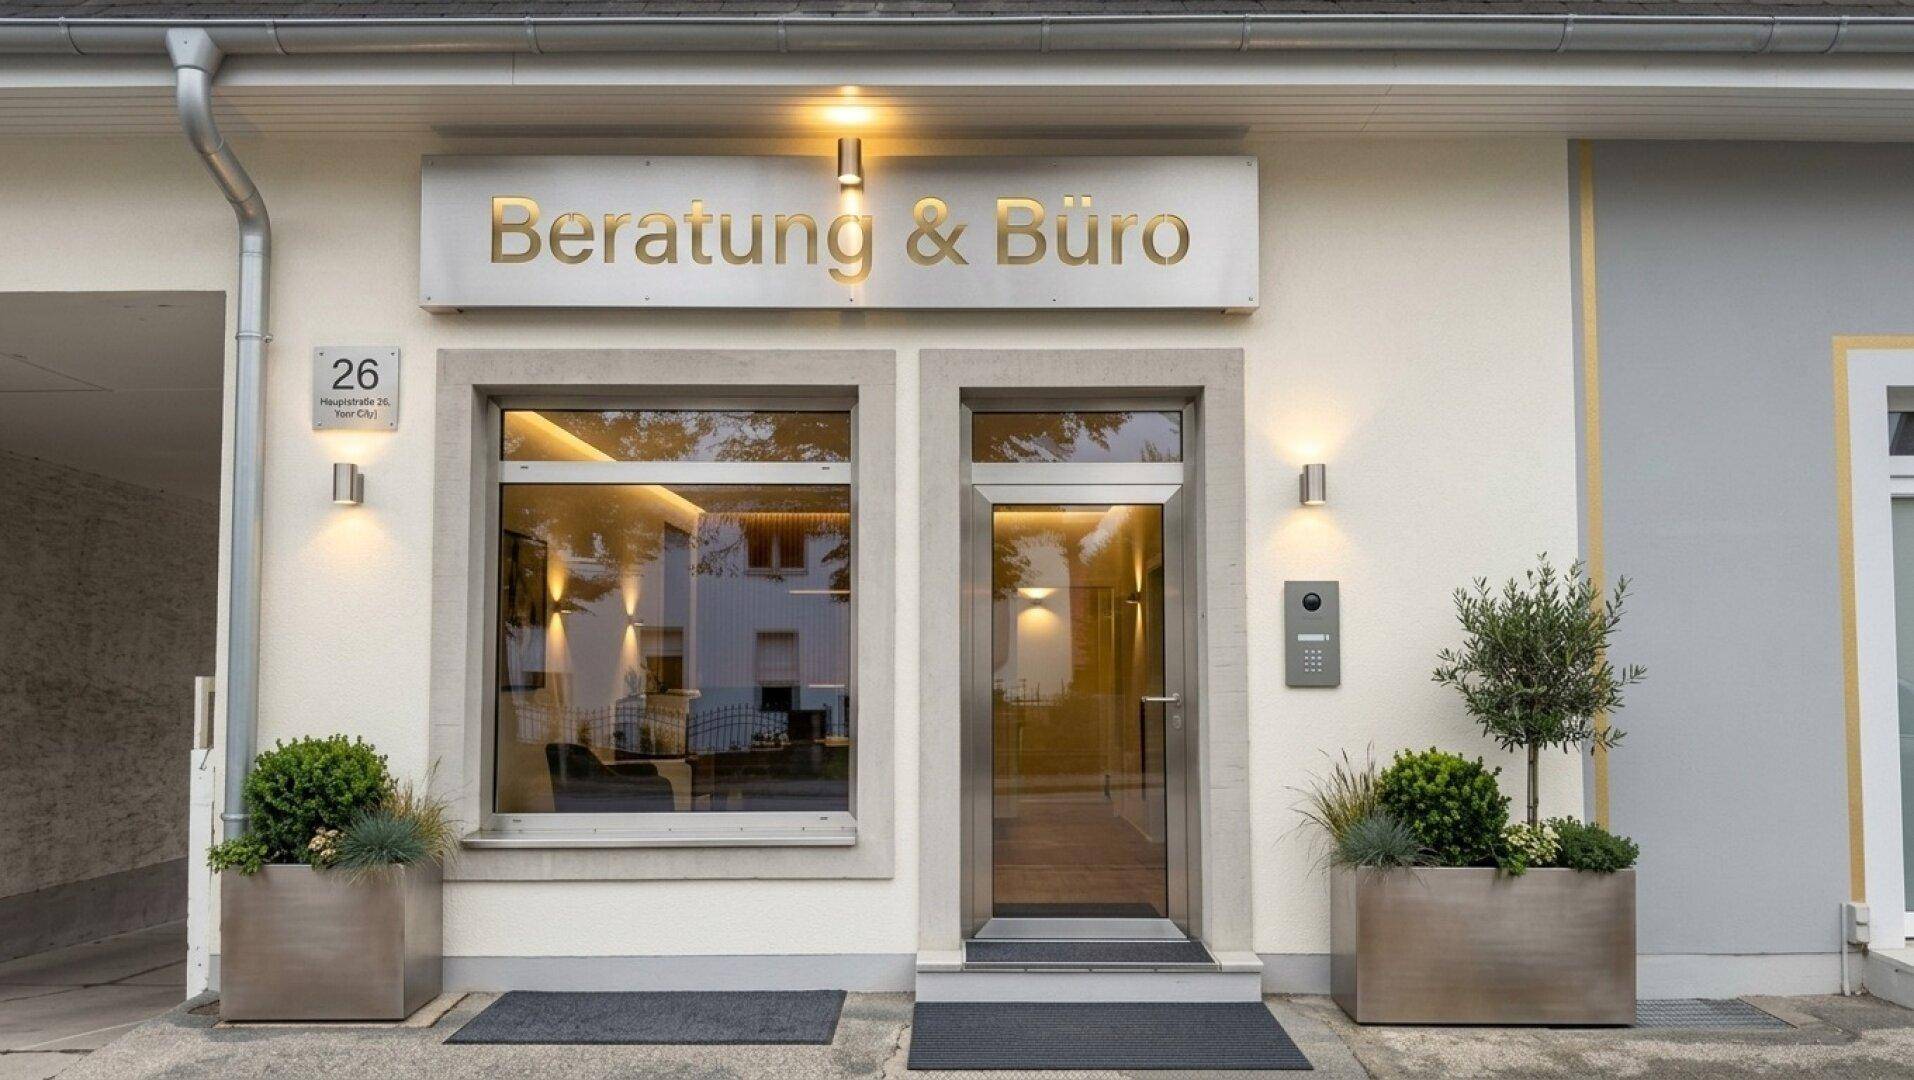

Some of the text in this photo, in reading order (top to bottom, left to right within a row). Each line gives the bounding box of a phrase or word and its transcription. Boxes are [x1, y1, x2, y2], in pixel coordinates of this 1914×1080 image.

[491, 195, 1190, 283] Beratung & Büro
[332, 358, 379, 390] 26
